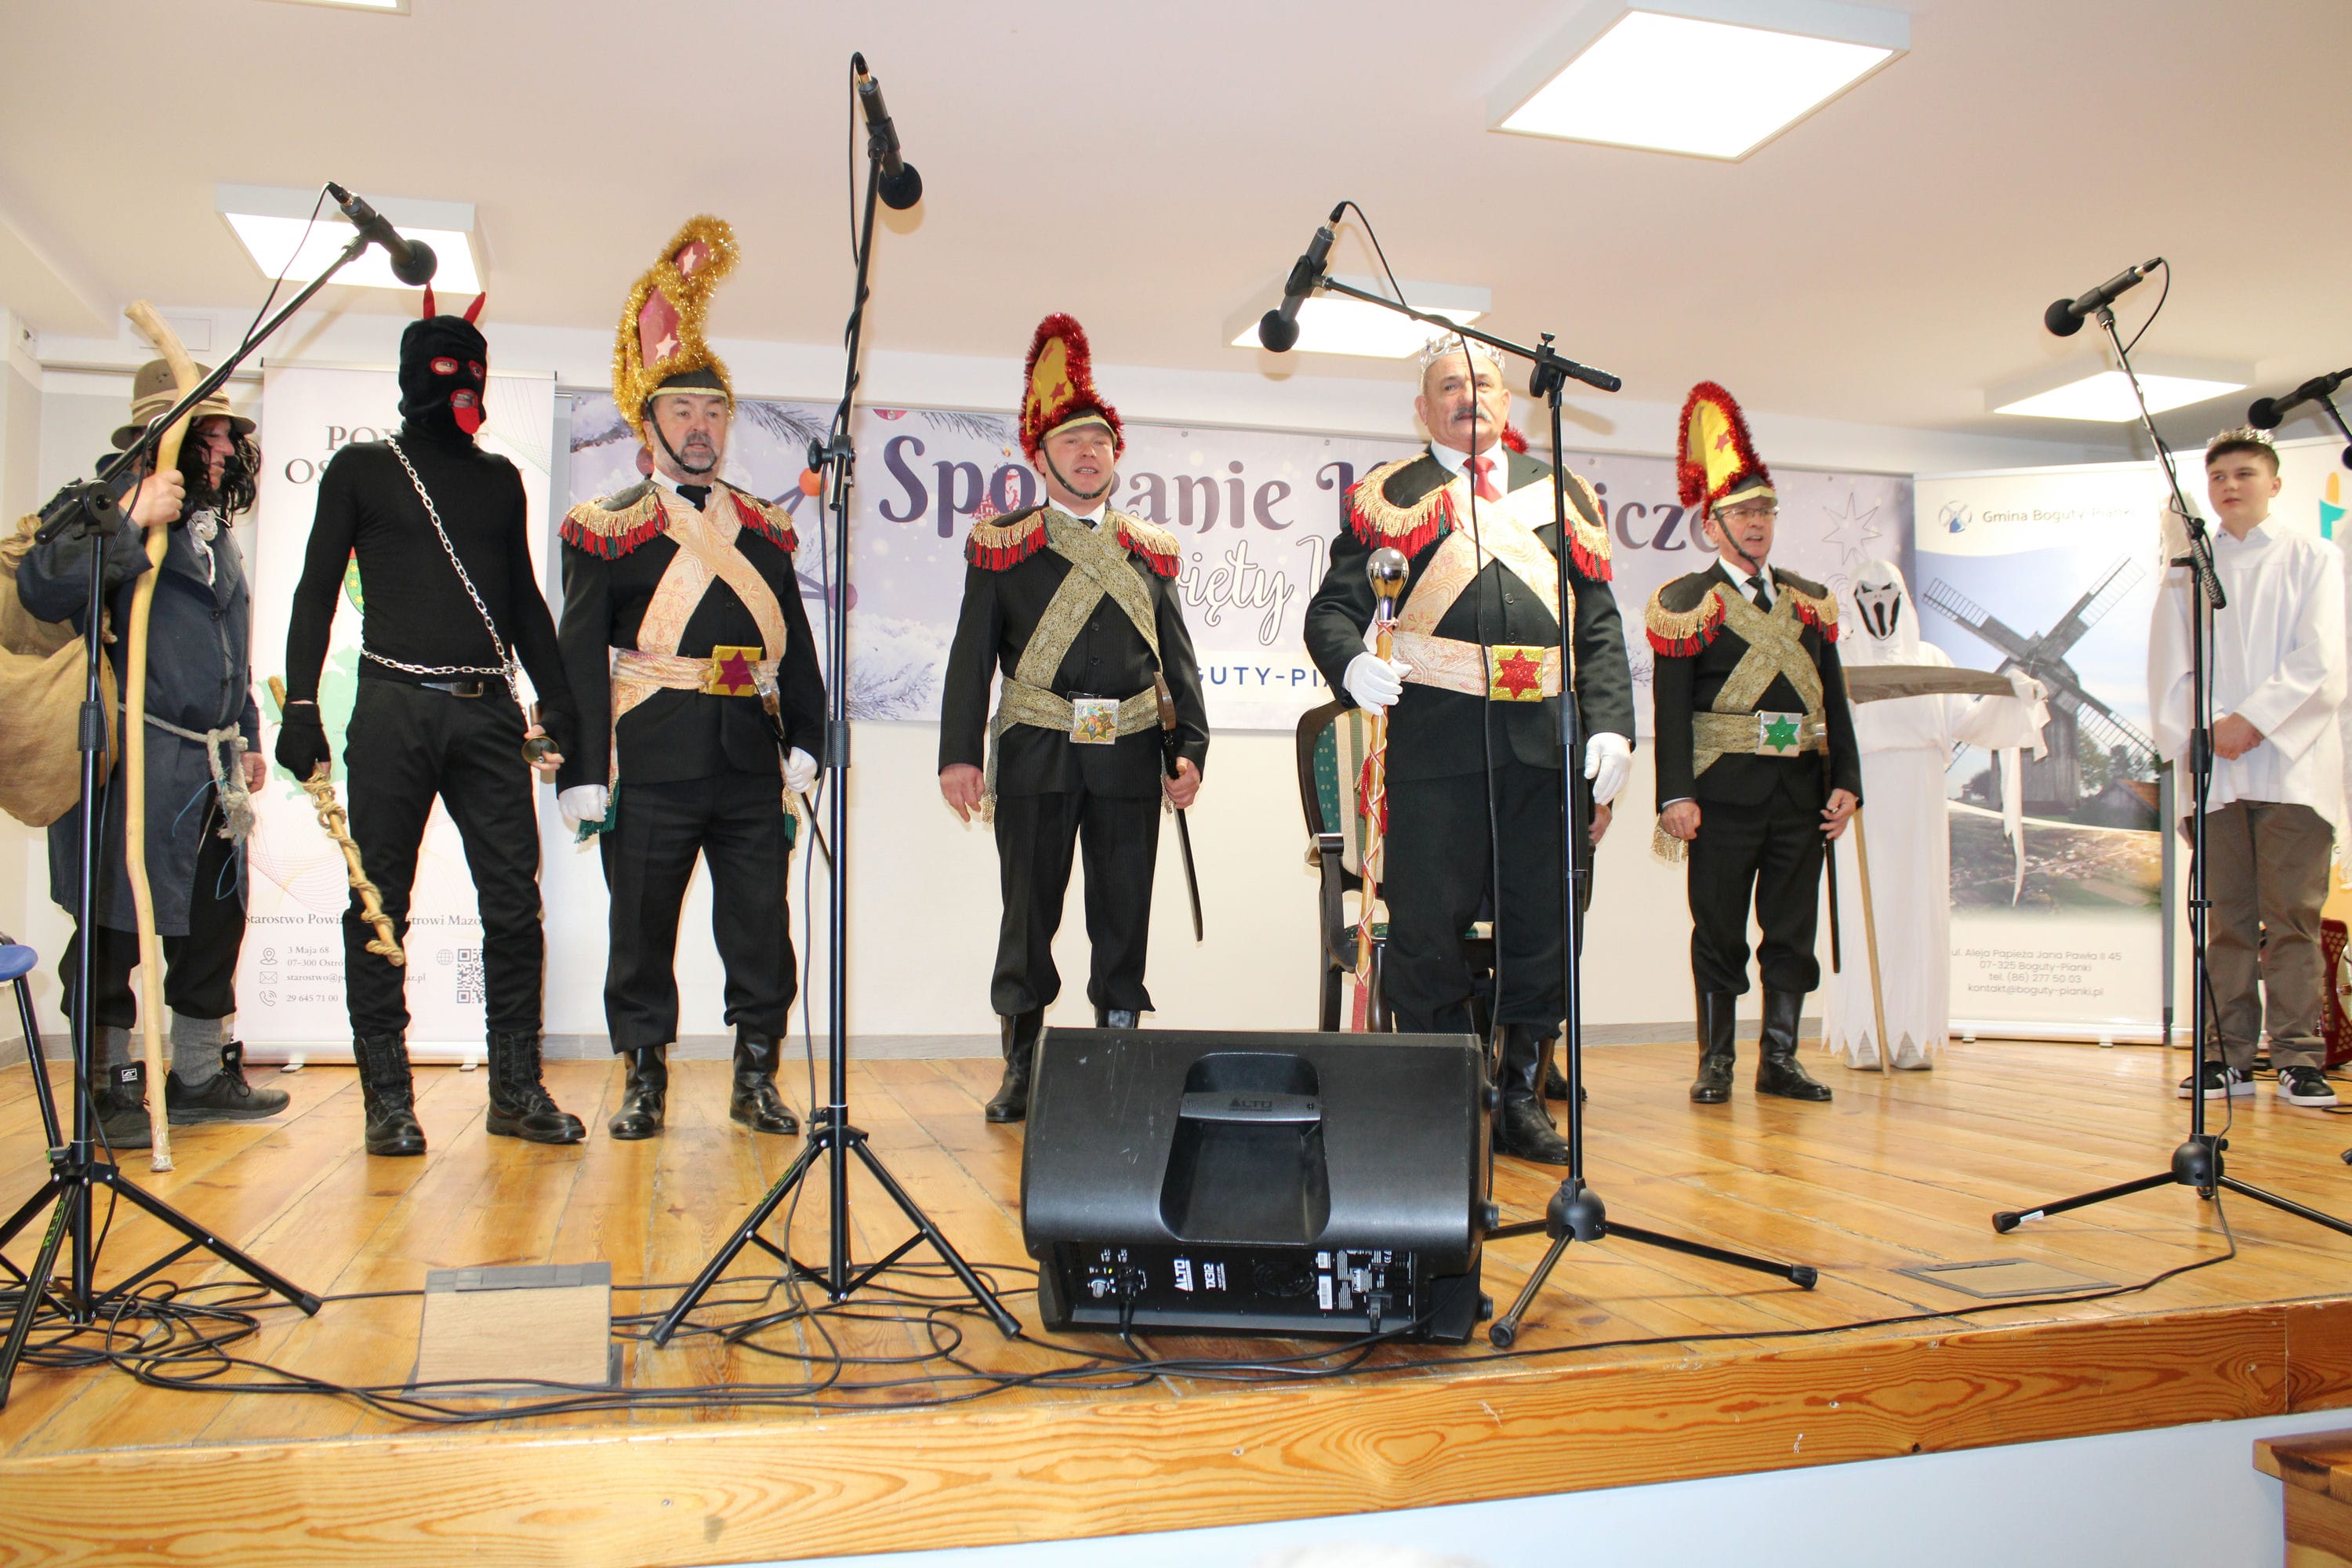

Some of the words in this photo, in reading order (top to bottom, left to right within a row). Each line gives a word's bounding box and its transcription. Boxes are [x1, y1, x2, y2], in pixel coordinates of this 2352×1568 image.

[879, 435, 1294, 538] Spoanie
[1983, 510, 2028, 523] Gmina
[1178, 539, 1295, 646] ięty
[1197, 666, 1329, 687] UTY-PI
[307, 913, 343, 924] Powi
[407, 915, 445, 925] strowi
[448, 915, 482, 925] Mazo
[296, 946, 317, 956] Maja
[1965, 949, 1990, 959] Aleja
[1992, 949, 2034, 960] Papieża
[2066, 951, 2097, 960] Pawła
[2108, 952, 2122, 960] 45
[319, 958, 343, 967] Ostró
[1980, 960, 2016, 970] 07-325
[2019, 961, 2092, 972] Boguty-Pianki
[1989, 972, 2004, 981] tel.
[2032, 974, 2050, 982] 277
[2053, 974, 2066, 983] 50
[2068, 975, 2082, 984] 03
[1968, 983, 2103, 997] kontakt@boguty-pianki.pl
[1174, 1259, 1189, 1291] ALTO
[1203, 1263, 1216, 1290] TX312
